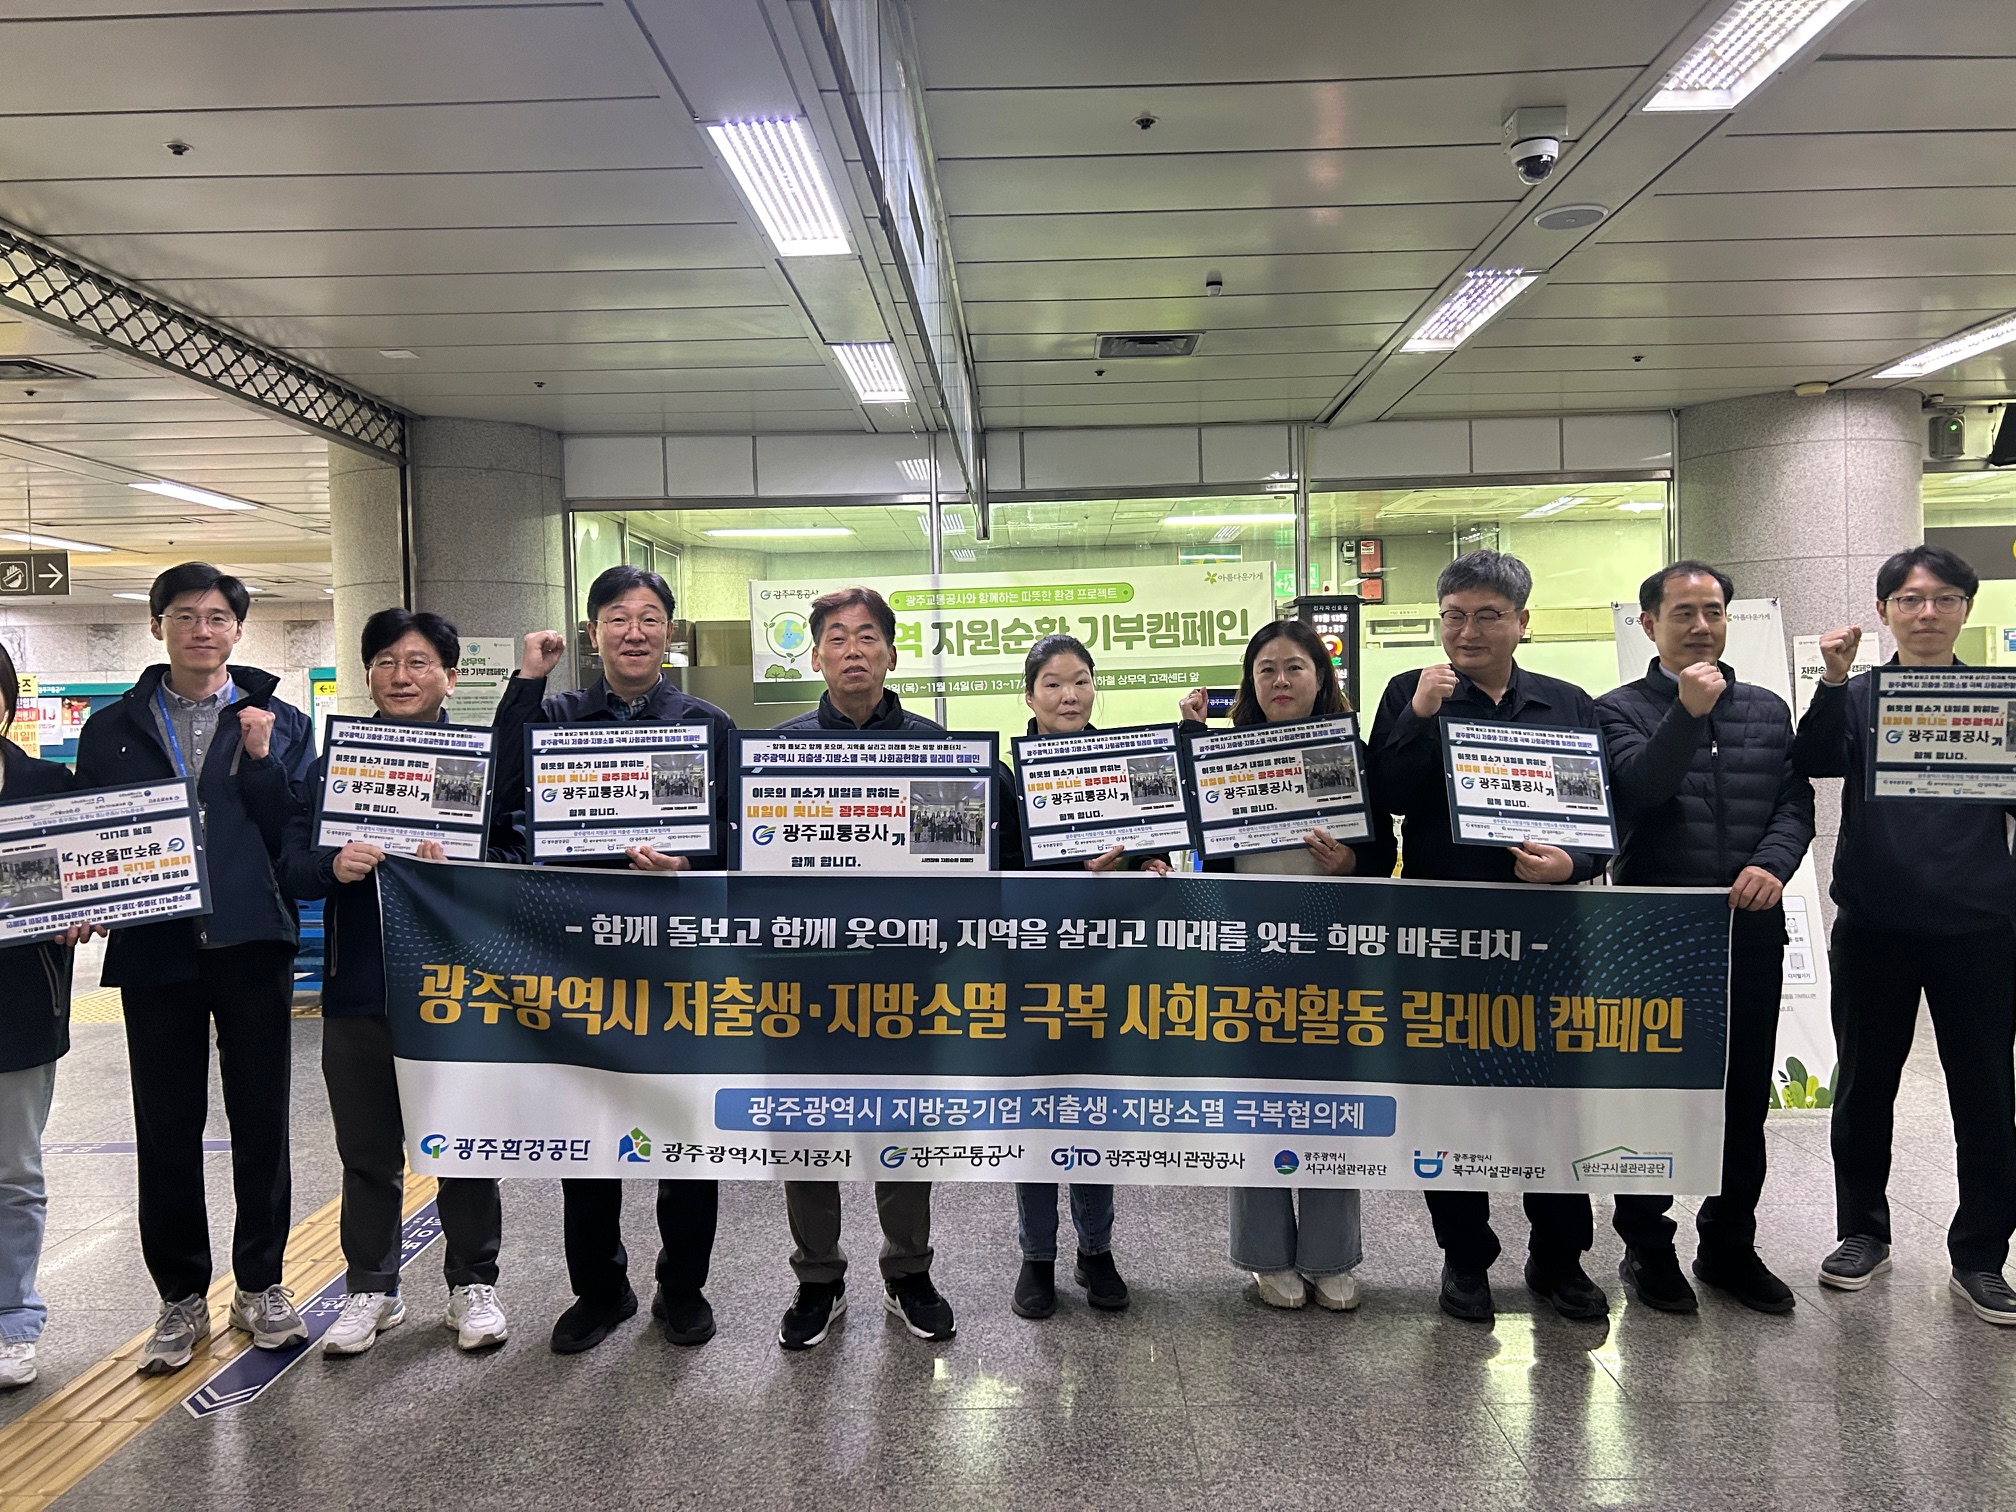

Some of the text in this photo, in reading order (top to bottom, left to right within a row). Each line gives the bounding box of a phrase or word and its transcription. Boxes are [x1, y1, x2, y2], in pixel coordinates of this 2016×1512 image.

[1218, 572, 1263, 582] 아름다운가게
[773, 590, 818, 599] 광주교통공사
[905, 588, 1117, 606] 광주교통공사와 함께하는 따뜻한 환경 프로젝트
[1078, 608, 1249, 651] 기부캠페인
[461, 658, 485, 666] 상무역
[471, 668, 508, 676] 기부캠페인
[950, 680, 988, 692] 14일(금)
[1118, 675, 1146, 685] 상무역
[1149, 673, 1187, 683] 고객센터
[1190, 672, 1199, 682] 앞
[1908, 730, 1989, 743] 광주교통공사
[753, 754, 980, 764] 광주광역시 저출생·지방소멸 극복 사회공헌활동 릴레이 캠페인
[352, 781, 419, 798] 광주교통공사
[562, 785, 637, 799] 광주교통공사
[752, 788, 900, 798] 이웃의 미소가 내일을 밝히는
[1224, 781, 1292, 800] 광주교통공사
[1479, 778, 1543, 793] 광주교통공사
[1051, 788, 1117, 805] 광주교통공사
[747, 806, 906, 818] 내일이 빛나는 광주광역시
[783, 824, 889, 842] 광주교통공사
[76, 843, 162, 866] 광주교통공사
[792, 856, 861, 867] 함께 합니다.
[592, 914, 1520, 962] 함께 돌보고 함께 웃으며, 지역을 살리고 미래를 잇는 희망 바톤터치
[418, 964, 1682, 1054] 광주광역시 저출생·지방소멸 극복 사회공헌활동 릴레이 캠페인
[747, 1094, 1365, 1131] 광주광역시 지방공기업 저출생·지방소멸 극복협의체
[454, 1138, 590, 1161] 광주환경공단
[662, 1143, 852, 1167] 광주광역시도시공사
[911, 1145, 1025, 1167] 광주교통공사
[1304, 1152, 1346, 1161] 광주광역시
[1453, 1153, 1492, 1162] 광주광역시
[1306, 1164, 1387, 1176] 서구시설관리공단
[1452, 1164, 1545, 1179] 북구시설관리공단
[1582, 1163, 1665, 1174] 광산구시설관리공단
